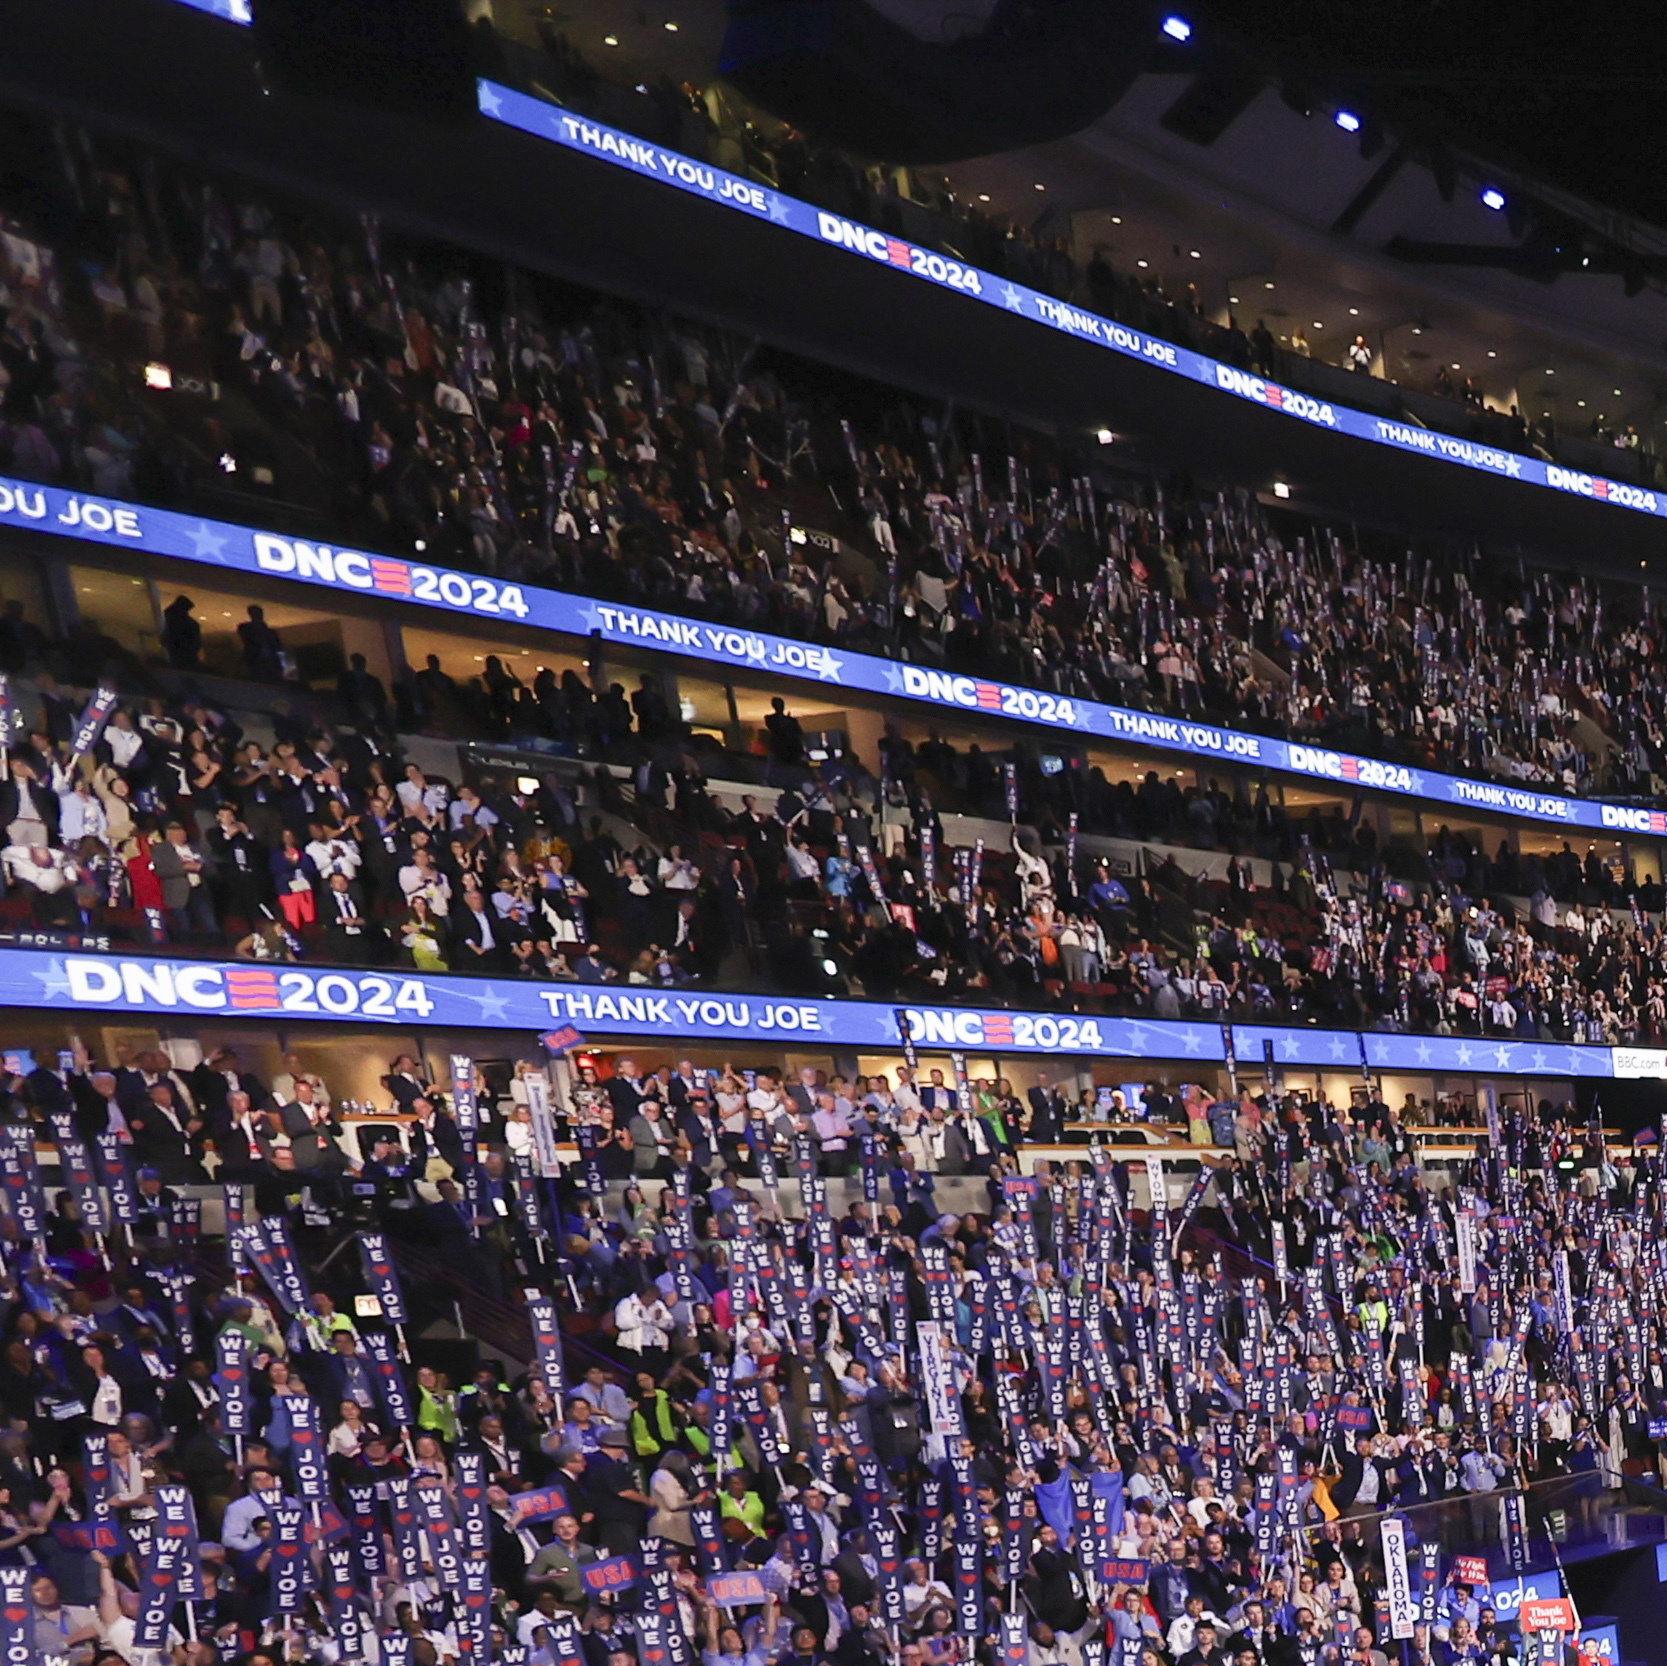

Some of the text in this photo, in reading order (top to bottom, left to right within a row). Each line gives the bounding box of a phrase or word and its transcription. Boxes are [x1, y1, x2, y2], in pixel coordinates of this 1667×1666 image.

[562, 117, 767, 211] THANK YOU JOE
[1035, 297, 1177, 366] THANK YOU JOE
[58, 499, 142, 537] JOE
[597, 607, 823, 673] THANK YOU JOE
[1108, 710, 1261, 758] THANK YOU JOE
[539, 991, 823, 1031] THANK YOU JOE
[1617, 1057, 1661, 1070] BBC.com
